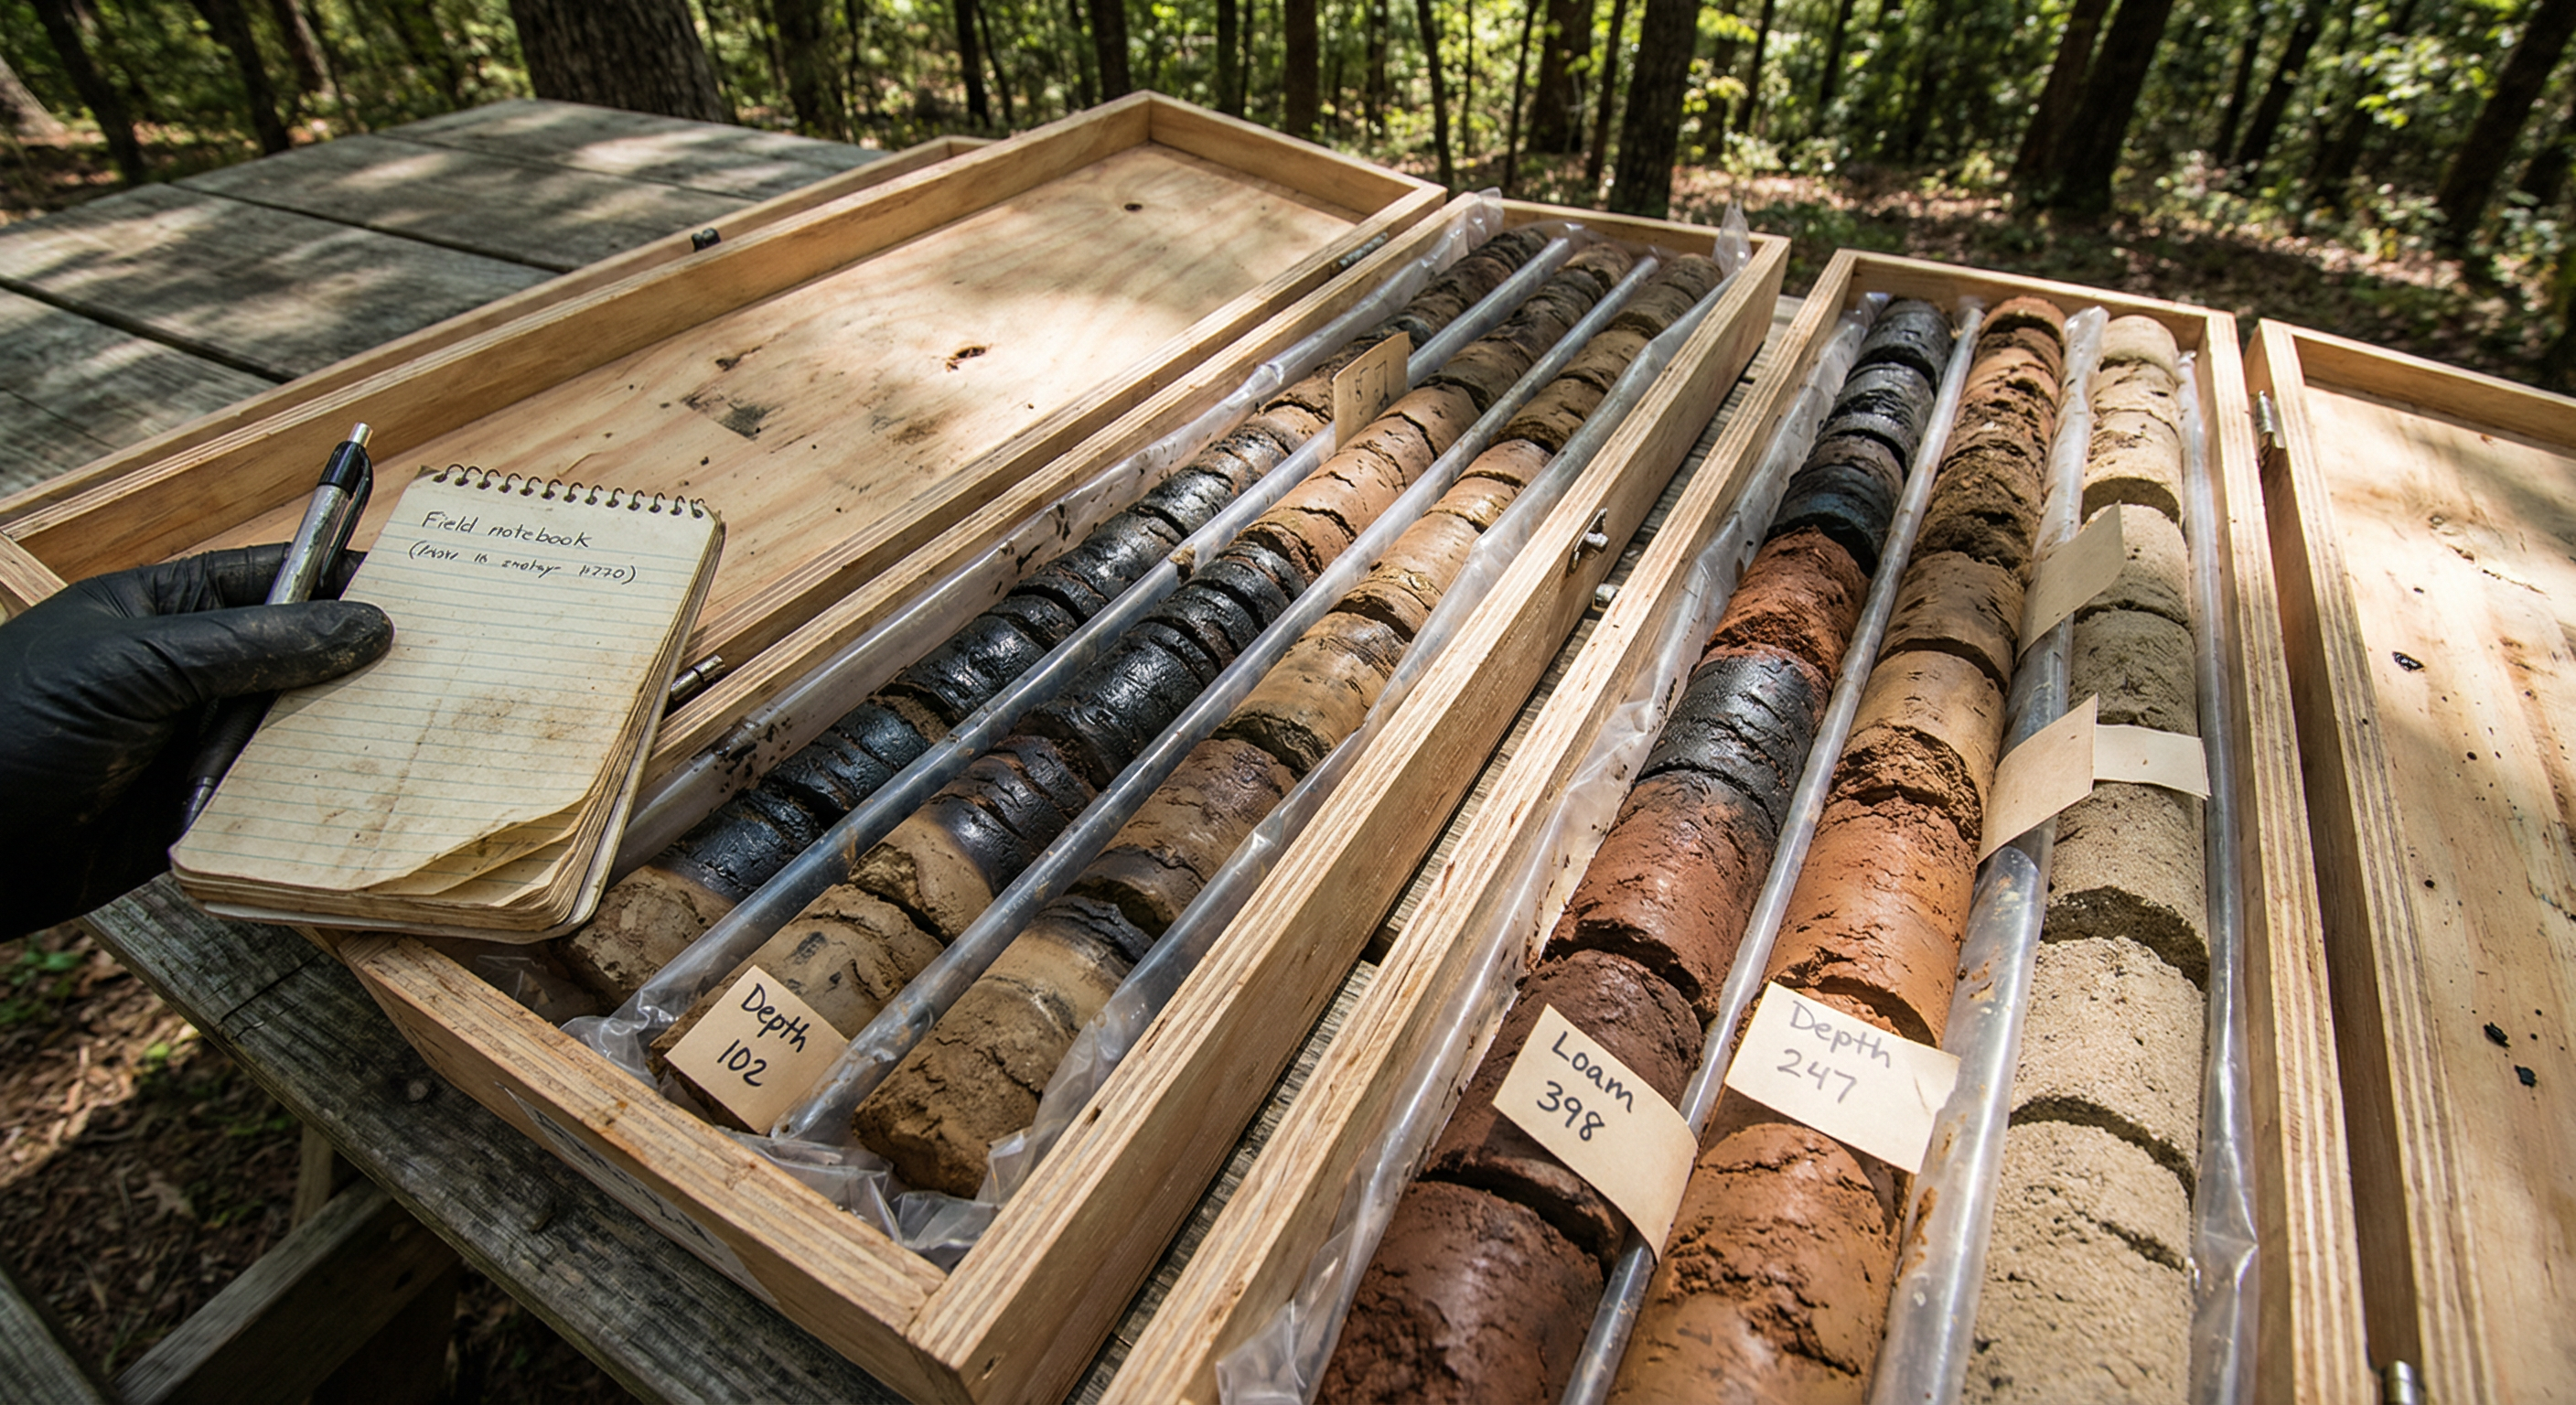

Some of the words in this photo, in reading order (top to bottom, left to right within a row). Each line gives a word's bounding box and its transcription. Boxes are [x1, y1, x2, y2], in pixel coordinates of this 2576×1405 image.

[421, 510, 479, 534] Field
[488, 525, 593, 548] notebook
[740, 982, 810, 1053] Depth
[1788, 1000, 1891, 1068] Depth
[716, 1039, 767, 1087] 102
[1551, 1031, 1635, 1113] Loam
[1776, 1048, 1858, 1105] 247
[1536, 1079, 1606, 1142] 398
